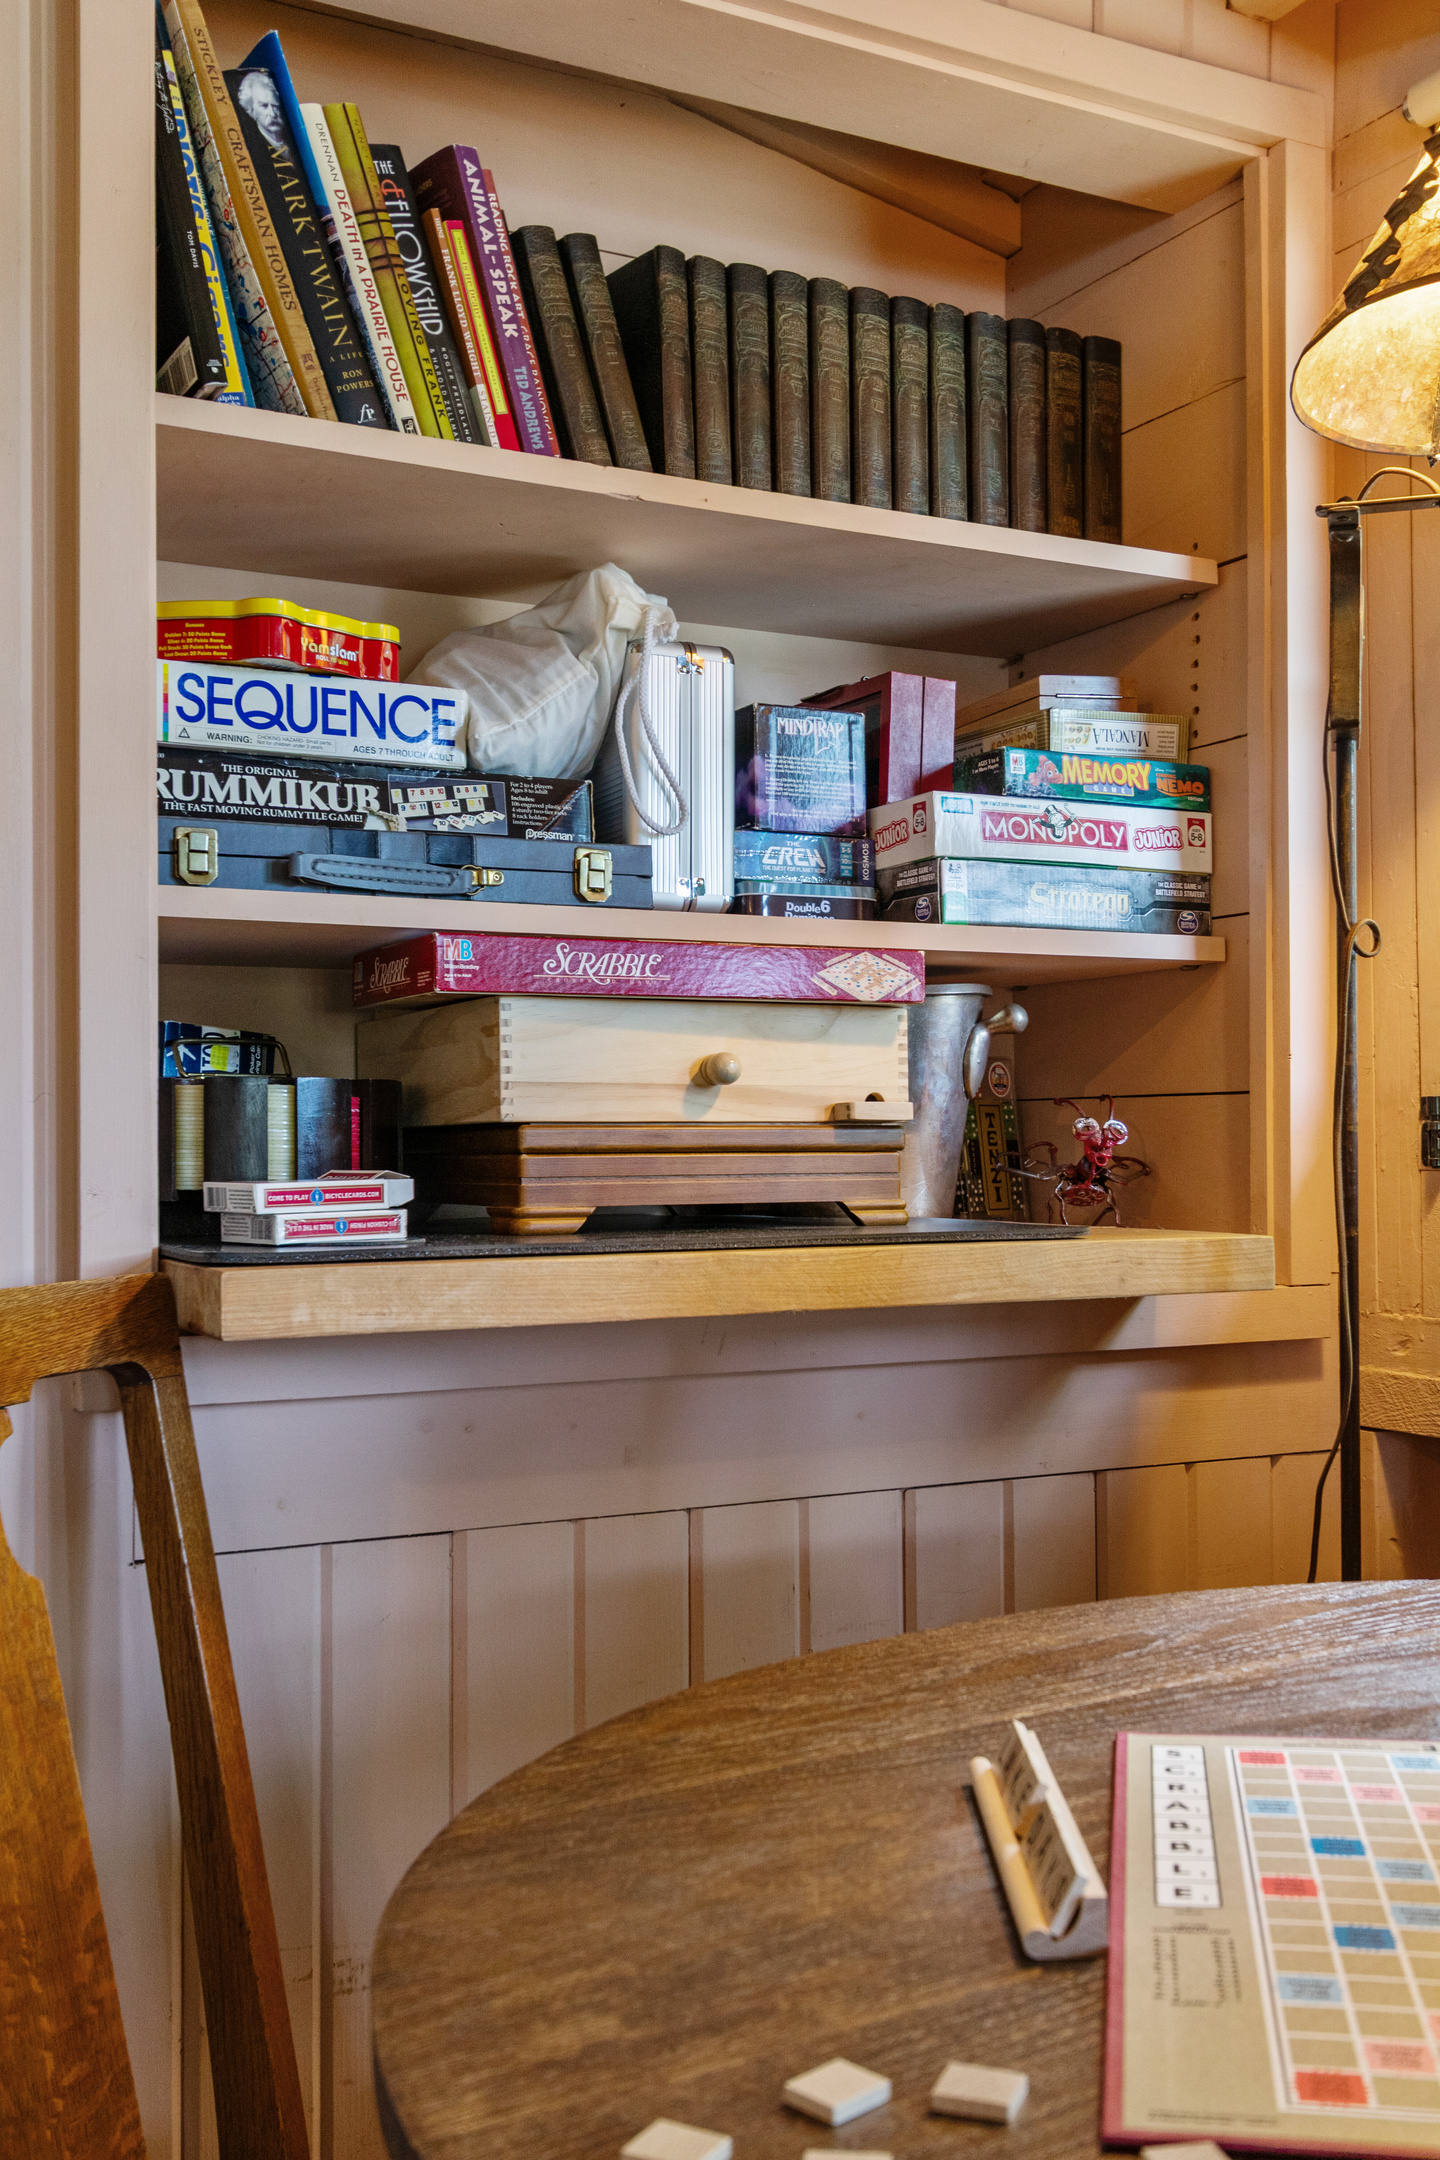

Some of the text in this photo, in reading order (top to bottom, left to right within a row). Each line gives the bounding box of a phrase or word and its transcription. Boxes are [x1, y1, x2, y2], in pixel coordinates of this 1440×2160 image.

[315, 123, 340, 182] DRENNAN
[354, 119, 369, 160] NANCY
[194, 28, 297, 311] STICKLEY CRAFTSMAN HOMES
[373, 160, 395, 175] THE
[334, 190, 360, 247] DEATH
[187, 230, 199, 269] TOM DAVIS
[268, 145, 353, 347] MARK TWAIN
[352, 248, 364, 261] IN
[464, 159, 519, 339] ANIMAL-SPEAK
[357, 264, 367, 274] A
[488, 193, 536, 365] READING ROCK ART GRACE
[361, 278, 391, 341] PRAIRIE
[434, 217, 497, 438] HEINZ FRANK LLOYD WRIGHT STAINED
[397, 273, 446, 418] LOVING FRANK
[480, 328, 489, 354] COMEDY
[488, 364, 497, 386] THREE
[336, 379, 374, 393] POWERS
[342, 368, 363, 380] RON
[381, 346, 409, 403] HOUSE
[432, 357, 447, 396] HAROLD
[441, 347, 472, 442] ROGER FRIEDLAND
[514, 366, 545, 451] TED ANDREWS
[301, 636, 357, 662] Yamslam
[315, 654, 330, 662] ROLL
[175, 671, 456, 747] SEQUENCE
[206, 731, 253, 744] WARNING:
[256, 734, 281, 742] CHOKING
[305, 737, 319, 745] Small
[777, 716, 844, 747] MINDTRAP
[1092, 727, 1151, 748] MANCALA
[353, 745, 454, 762] AGES 7 THROUGH ADULT
[222, 763, 299, 779] THE ORIGINAL
[1062, 754, 1151, 791] MEMORY
[1156, 777, 1204, 795] NEMO
[157, 768, 380, 814] RUMMIKUB
[1093, 785, 1126, 795] GAME
[163, 801, 363, 823] THE FAST MOVING RUMMY TILE GAME!
[915, 817, 925, 828] 5-8
[985, 814, 1125, 847] MONOPOLY
[1190, 833, 1203, 842] 5-8
[762, 846, 826, 868] CREW
[862, 843, 870, 880] KOSMOS
[785, 900, 831, 914] Double6
[1031, 882, 1129, 915] Stratego
[1155, 888, 1206, 898] BATTLEFIELD STRATEGY
[443, 938, 472, 960] MB
[543, 942, 662, 985] SCRABBLE
[984, 1112, 1003, 1203] TENZI
[324, 1191, 380, 1200] BICYCLECARDS.COM
